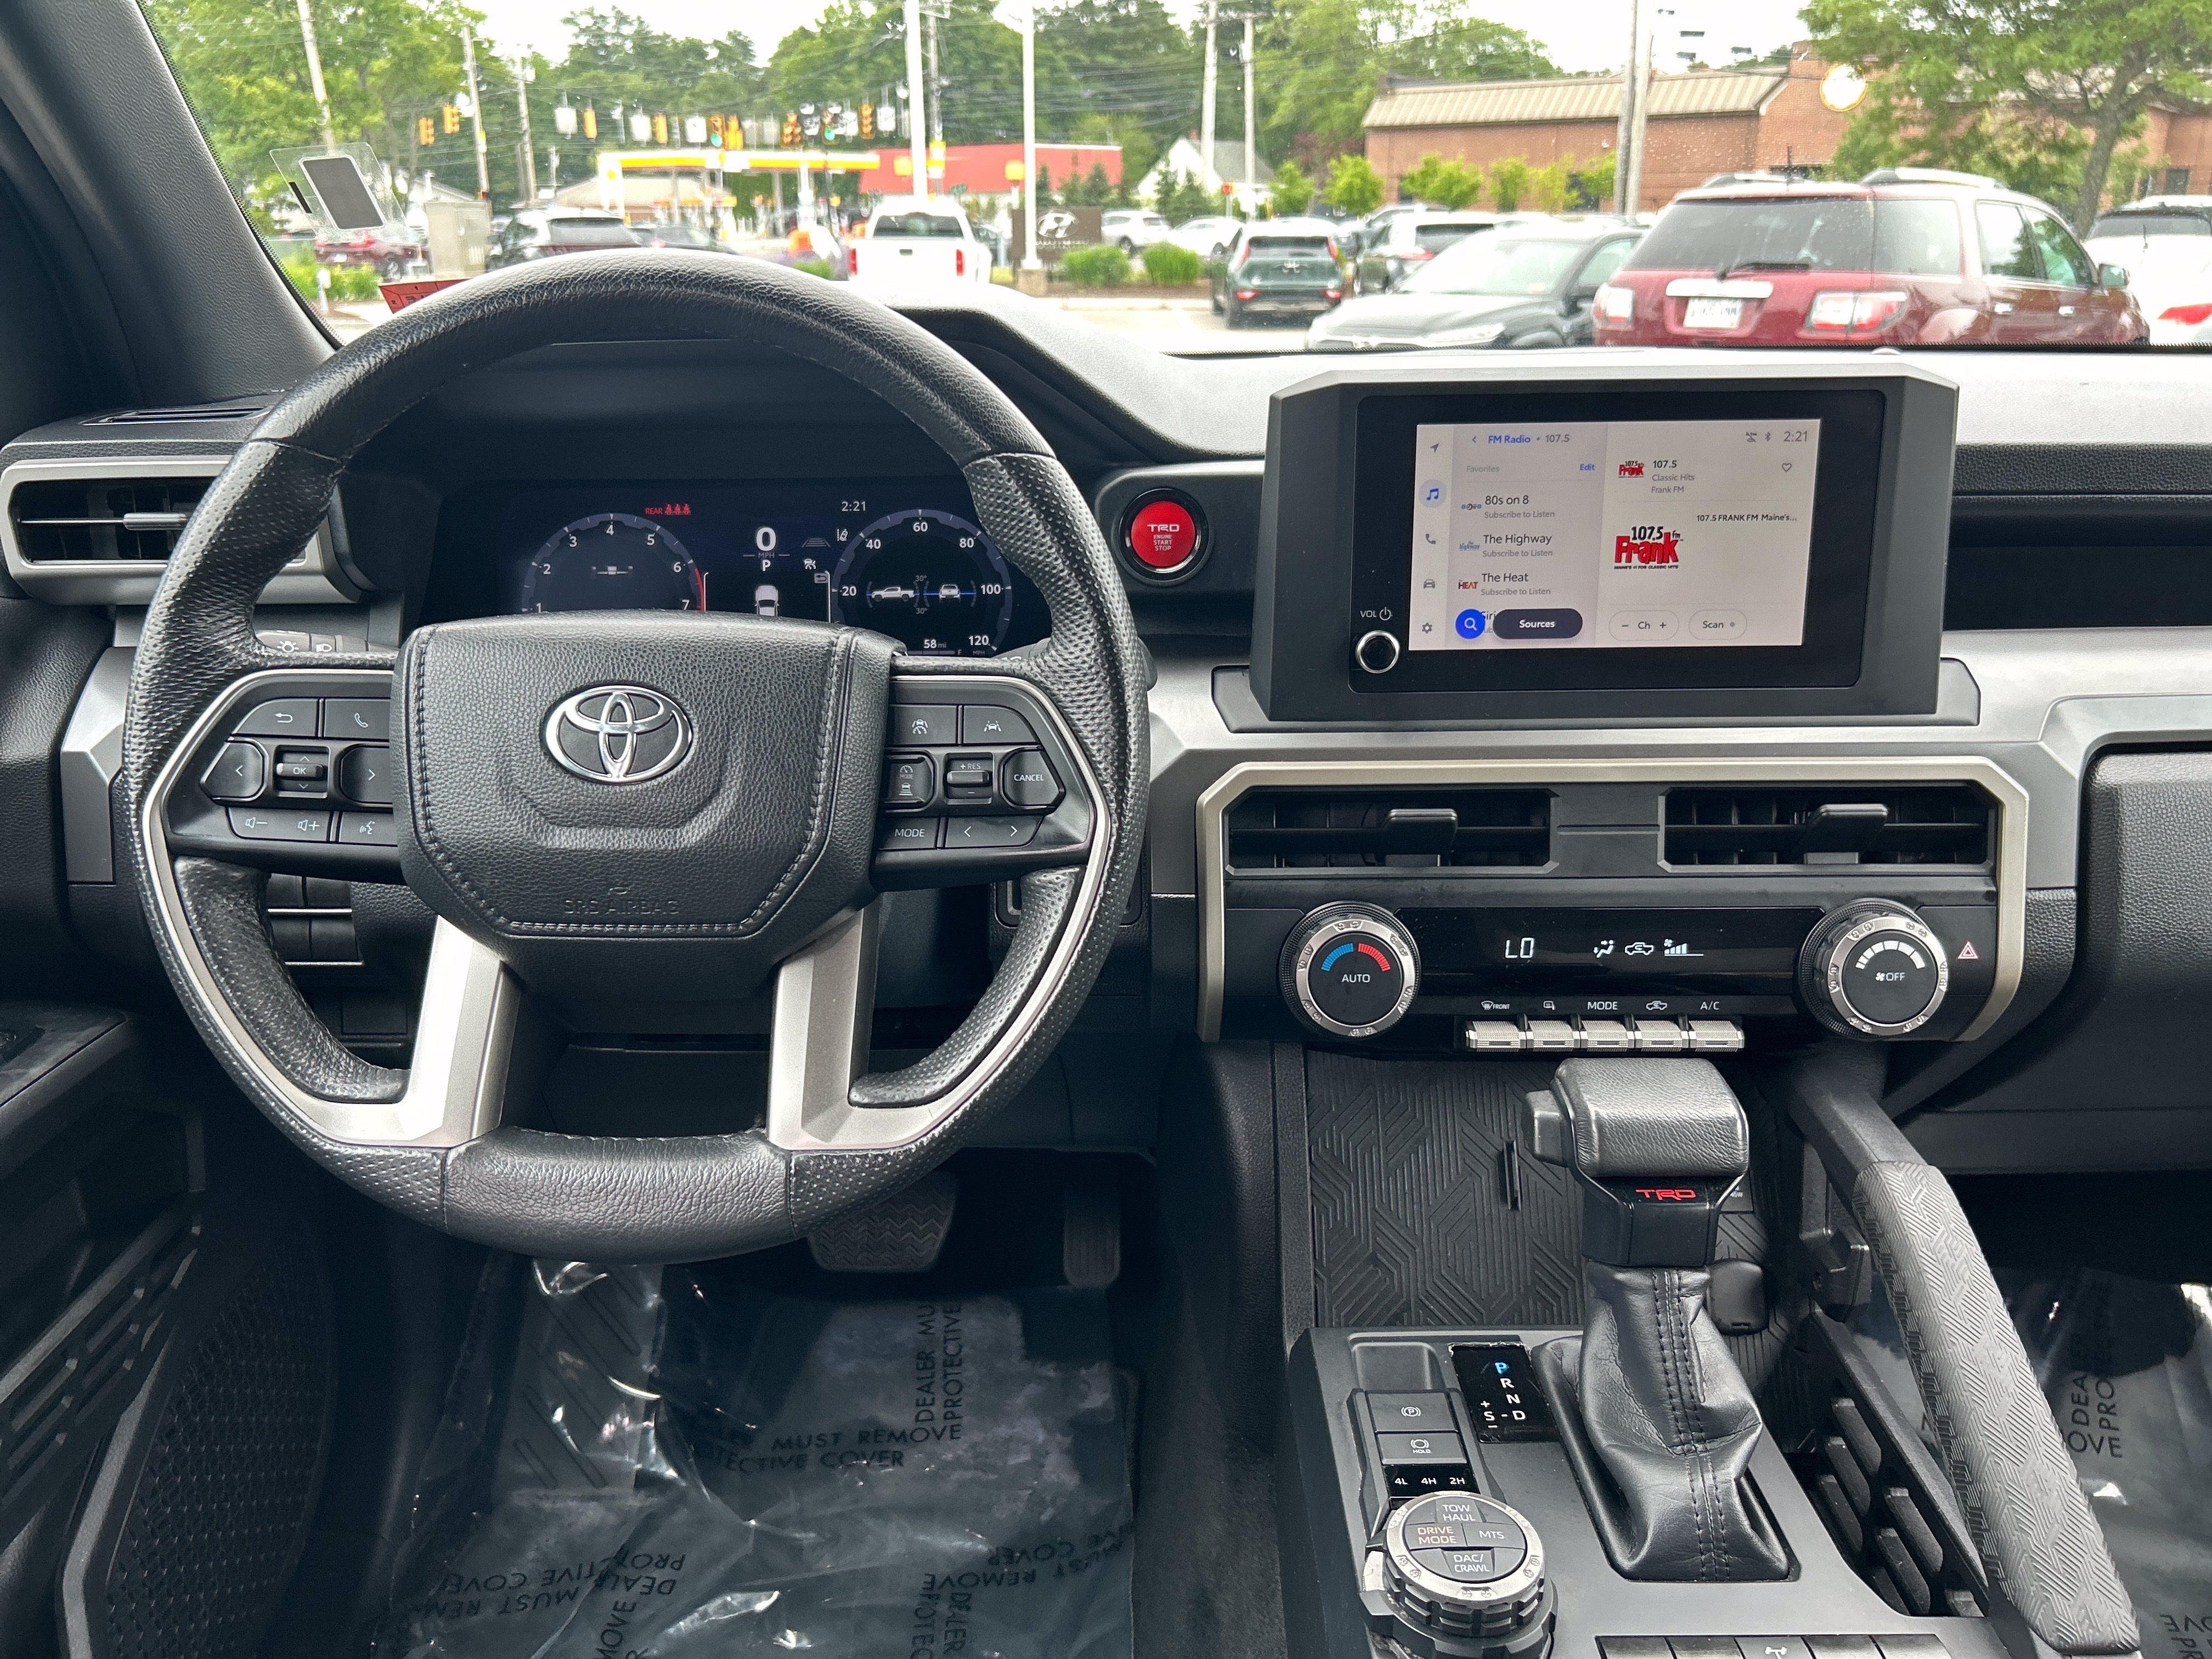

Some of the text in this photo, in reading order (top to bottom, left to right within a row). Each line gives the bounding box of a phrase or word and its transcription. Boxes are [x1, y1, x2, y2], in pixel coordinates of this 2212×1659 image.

[1488, 434, 1570, 443] FM Radio 107.5
[1784, 431, 1808, 442] 2:21
[1652, 473, 1678, 482] Classic
[1485, 495, 1504, 505] 80s
[1522, 495, 1529, 504] 8
[841, 500, 866, 512] 2:21
[606, 524, 615, 535] 4
[912, 522, 928, 532] 60
[1147, 524, 1180, 533] TRD
[1631, 526, 1681, 540] 107.5 fm
[569, 536, 577, 548] 3
[647, 533, 656, 546] 5
[755, 527, 777, 551] 0
[866, 539, 882, 550] 40
[960, 538, 974, 548] 80
[1483, 534, 1552, 546] The Highway
[1615, 532, 1679, 564] Frank
[543, 563, 551, 574] 2
[673, 561, 681, 573] 6
[762, 560, 771, 572] P
[1481, 572, 1529, 583] The Heat
[842, 585, 857, 596] 20
[980, 584, 1001, 595] 100
[536, 602, 542, 613] 1
[682, 599, 690, 611] 7
[1519, 619, 1555, 628] Sources
[1638, 621, 1650, 629] Ch
[1702, 620, 1724, 629] Scan
[923, 639, 936, 649] 58
[968, 635, 989, 646] 120
[292, 766, 307, 775] OK
[1014, 774, 1044, 782] CANCEL
[895, 828, 924, 838] MODE
[1505, 937, 1534, 958] LO
[1341, 973, 1370, 984] AUTO
[1886, 972, 1905, 982] OFF
[1587, 1001, 1618, 1011] MODE
[1700, 1000, 1720, 1011] A/C
[1635, 1189, 1696, 1200] TRD
[943, 1305, 963, 1420] PROTECTIVE
[1494, 1361, 1509, 1374] P
[915, 1350, 935, 1423] DEALER
[1500, 1378, 1514, 1389] R
[1506, 1394, 1520, 1404] N
[1484, 1410, 1526, 1421] S D
[771, 1432, 841, 1451] MUST
[858, 1424, 961, 1444] REMOVE
[1394, 1477, 1408, 1486] 4L
[1421, 1477, 1437, 1486] 4H
[1449, 1477, 1465, 1486] 2H
[1442, 1504, 1471, 1513] TOW
[1442, 1513, 1476, 1522] HAUL
[1418, 1525, 1454, 1535] DRIVE
[1479, 1531, 1504, 1540] MTS
[1418, 1535, 1457, 1545] MODE
[1453, 1554, 1483, 1564] DAC/
[1454, 1564, 1490, 1573] CRAWL
[922, 1568, 1036, 1590] REMOVE
[498, 1587, 579, 1615] MUST
